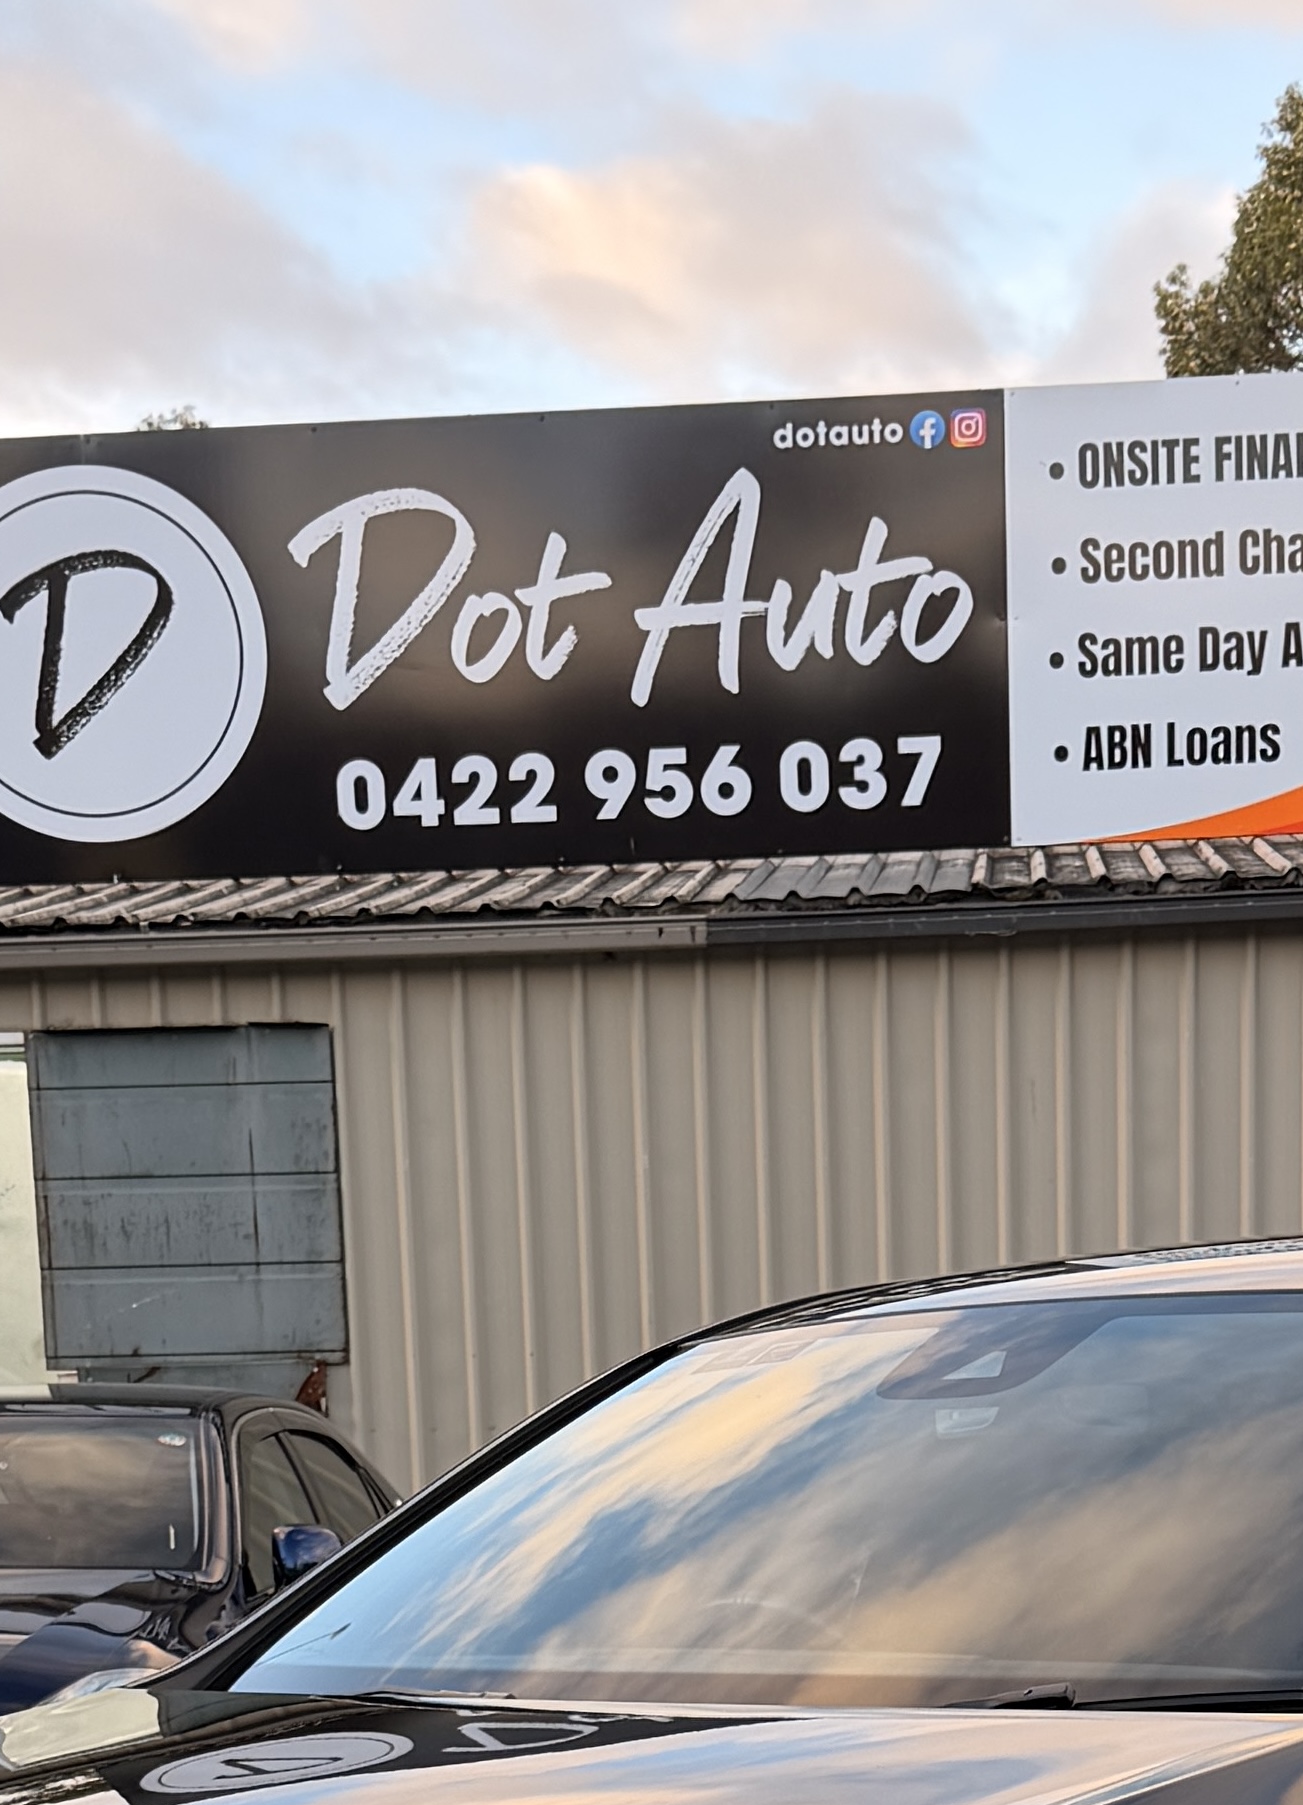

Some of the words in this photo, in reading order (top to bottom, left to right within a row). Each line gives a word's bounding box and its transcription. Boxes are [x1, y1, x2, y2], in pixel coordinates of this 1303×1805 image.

[773, 417, 904, 449] dotauto
[1078, 437, 1201, 490] ONSITE
[1080, 530, 1225, 584] Second
[287, 487, 613, 711] Dot
[631, 467, 974, 708] Auto
[1077, 632, 1185, 679] Same
[1198, 626, 1268, 677] Day
[1082, 723, 1152, 772] ABN
[1166, 721, 1281, 767] Loans
[336, 752, 558, 831] 0422
[584, 744, 753, 820] 956
[778, 735, 942, 813] 037
